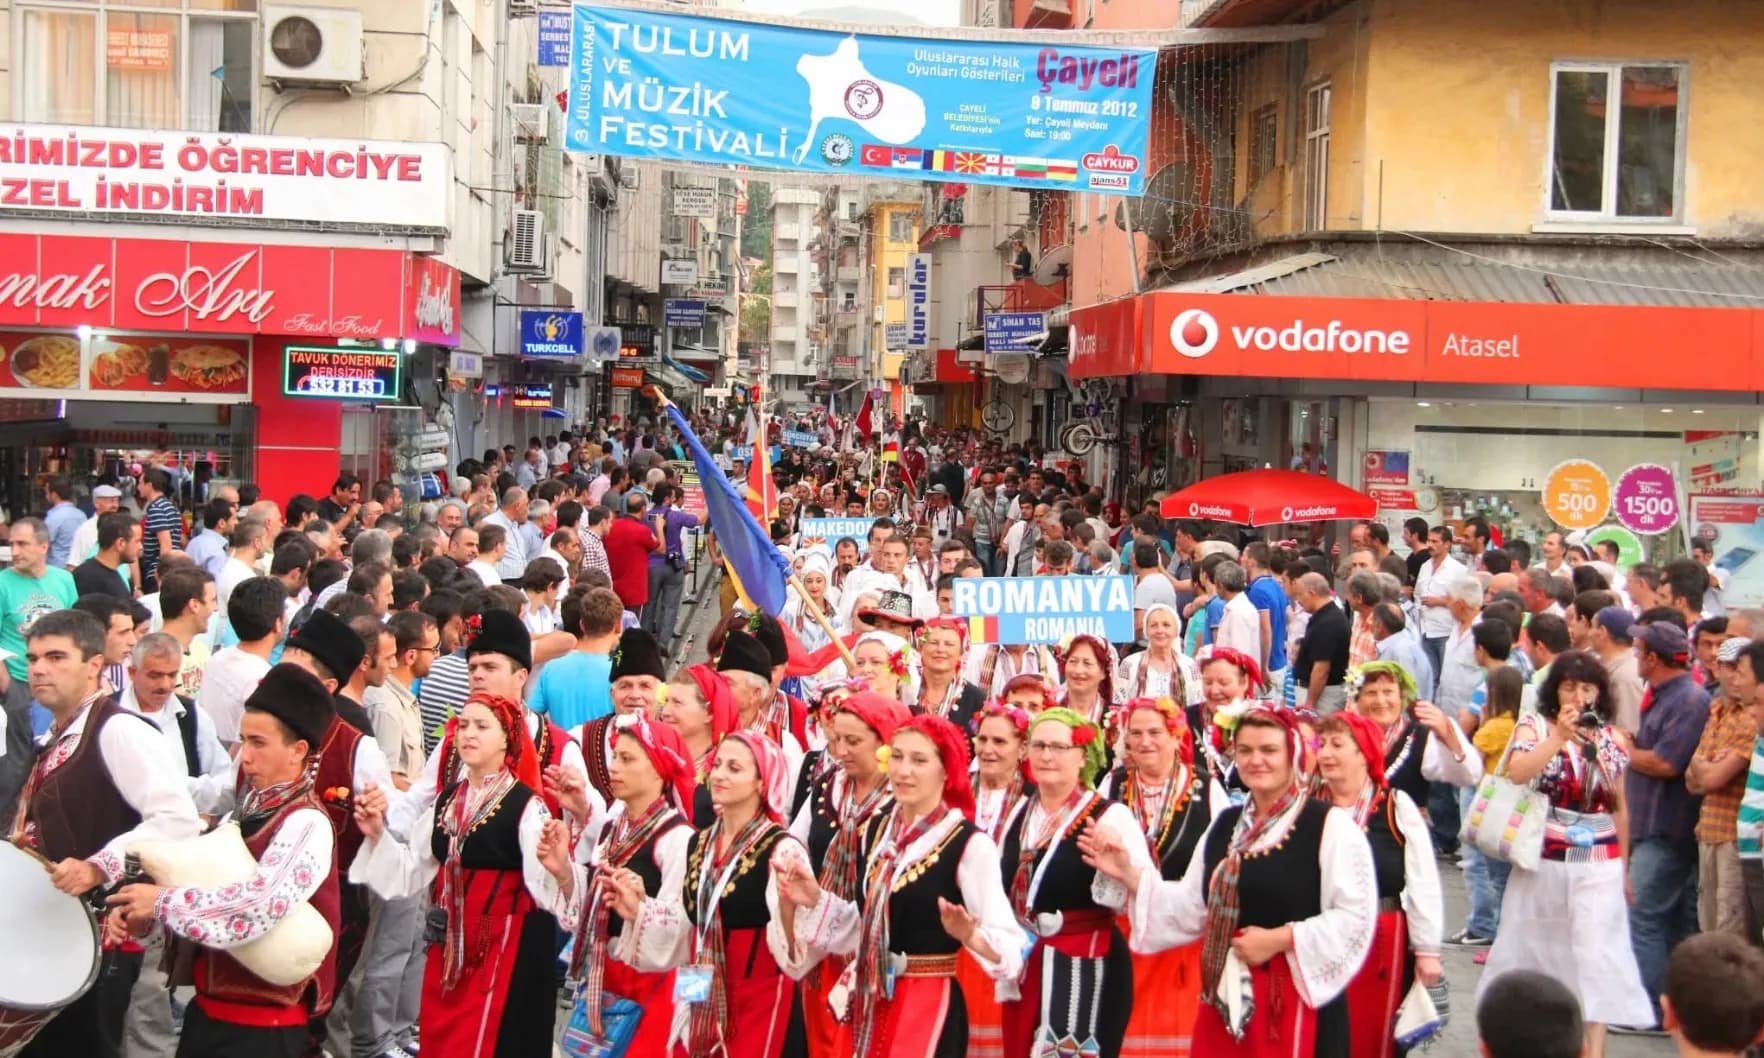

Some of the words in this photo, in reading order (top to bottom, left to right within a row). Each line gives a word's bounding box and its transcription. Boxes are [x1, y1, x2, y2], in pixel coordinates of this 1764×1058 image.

[604, 22, 750, 61] TULUM
[603, 57, 631, 76] VE
[914, 47, 989, 66] Uluslararası
[991, 54, 1020, 69] Halk
[906, 62, 958, 78] Oyunları
[960, 66, 1025, 83] Gösterileri
[1036, 48, 1139, 92] Çayeli
[602, 78, 728, 118] MÜZİK
[1031, 95, 1041, 111] 9
[1044, 97, 1099, 115] Temmuz
[1101, 100, 1138, 118] 2012
[1025, 115, 1042, 125] Yer:
[1044, 117, 1071, 130] Çayeli
[1072, 119, 1108, 131] Meydanı
[599, 116, 788, 158] FESTİVALİ
[178, 136, 422, 181] ÖĞRENCİYE
[1, 178, 81, 208] ZEL
[96, 174, 264, 214] İNDİRİM
[283, 313, 329, 333] Fast
[331, 316, 383, 336] Food
[525, 343, 576, 354] TURKCELL
[1231, 319, 1410, 354] vodafone
[1441, 332, 1520, 359] Atasel
[290, 352, 329, 365] TAVUK
[332, 352, 397, 368] DÖNERİMİZ
[310, 366, 375, 379] DERİSİZDİR
[310, 379, 335, 393] 532
[338, 380, 354, 393] 81
[357, 381, 374, 394] 53
[1199, 506, 1232, 518] vodafone
[1294, 506, 1337, 518] vodafone
[1558, 493, 1598, 512] 500
[1623, 497, 1674, 515] 1500
[1569, 511, 1584, 521] dk
[1639, 514, 1655, 524] dk
[955, 577, 1130, 614] ROMANYA
[1025, 616, 1107, 641] ROMANIA
